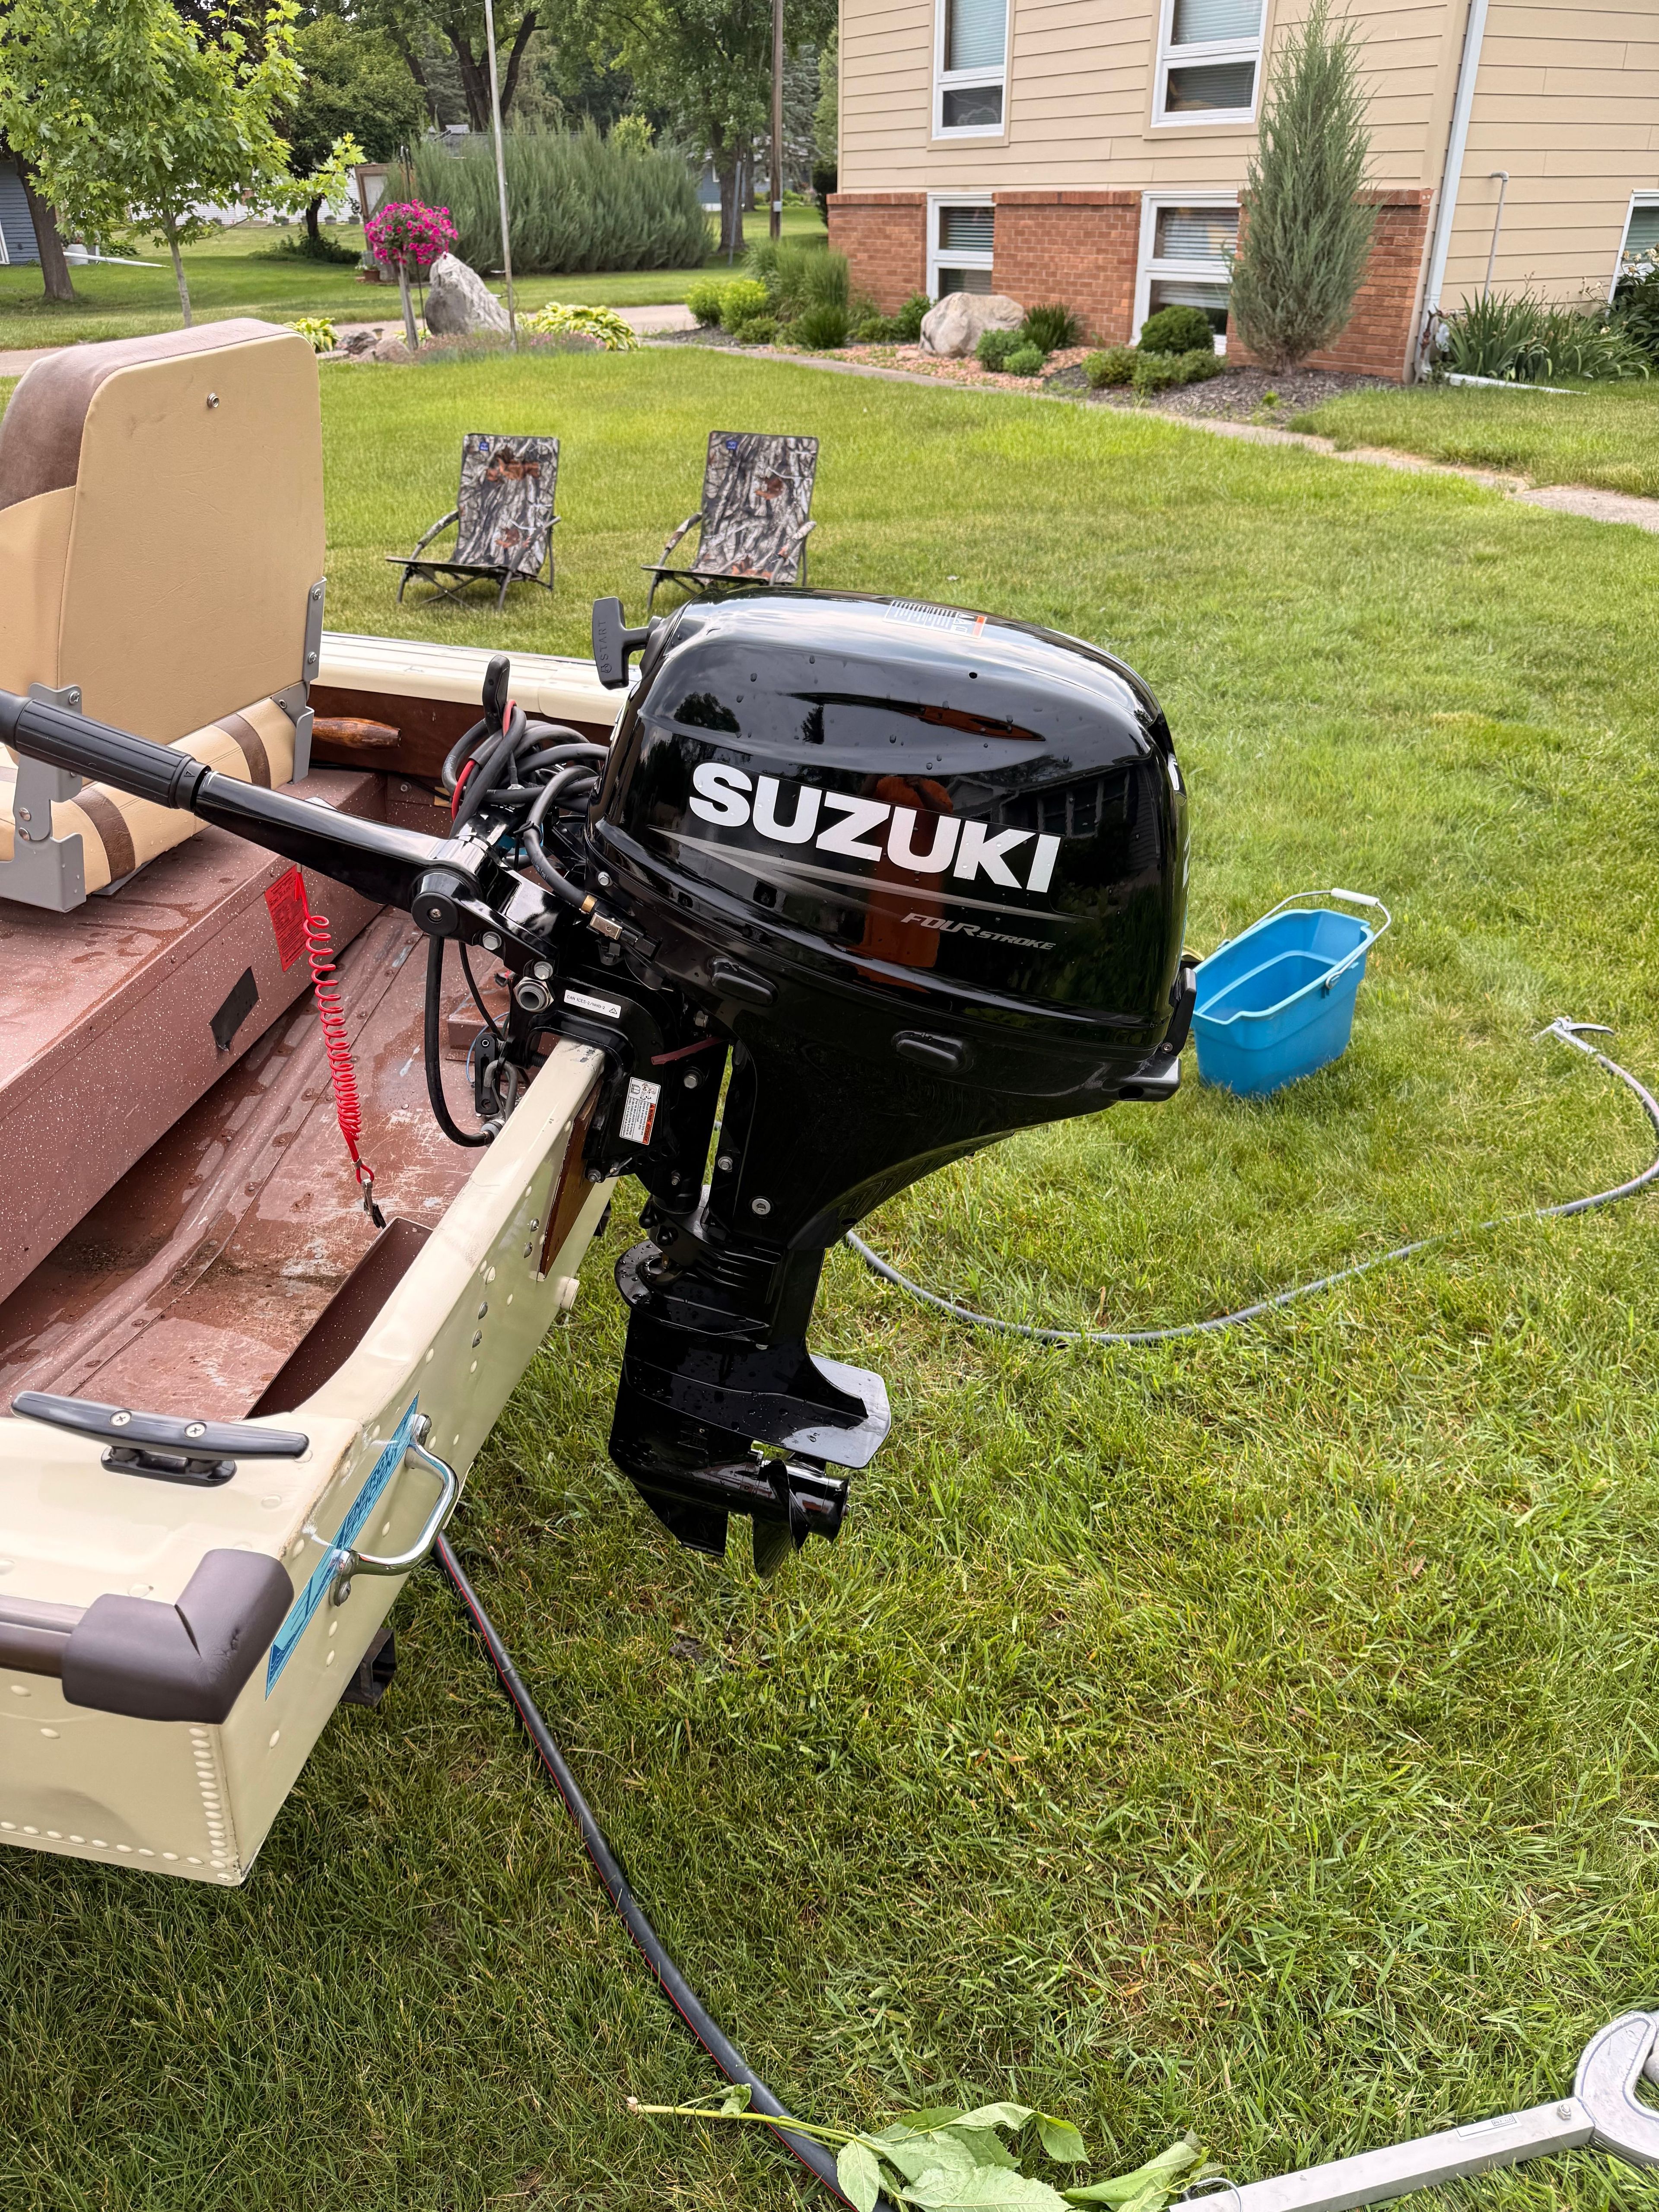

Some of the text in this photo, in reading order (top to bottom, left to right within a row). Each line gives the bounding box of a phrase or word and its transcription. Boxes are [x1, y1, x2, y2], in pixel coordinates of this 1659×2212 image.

[598, 619, 608, 660] START
[689, 762, 1061, 893] SUZUKI
[900, 912, 1056, 950] FOUR STROKE
[347, 1445, 391, 1521] ENERGY
